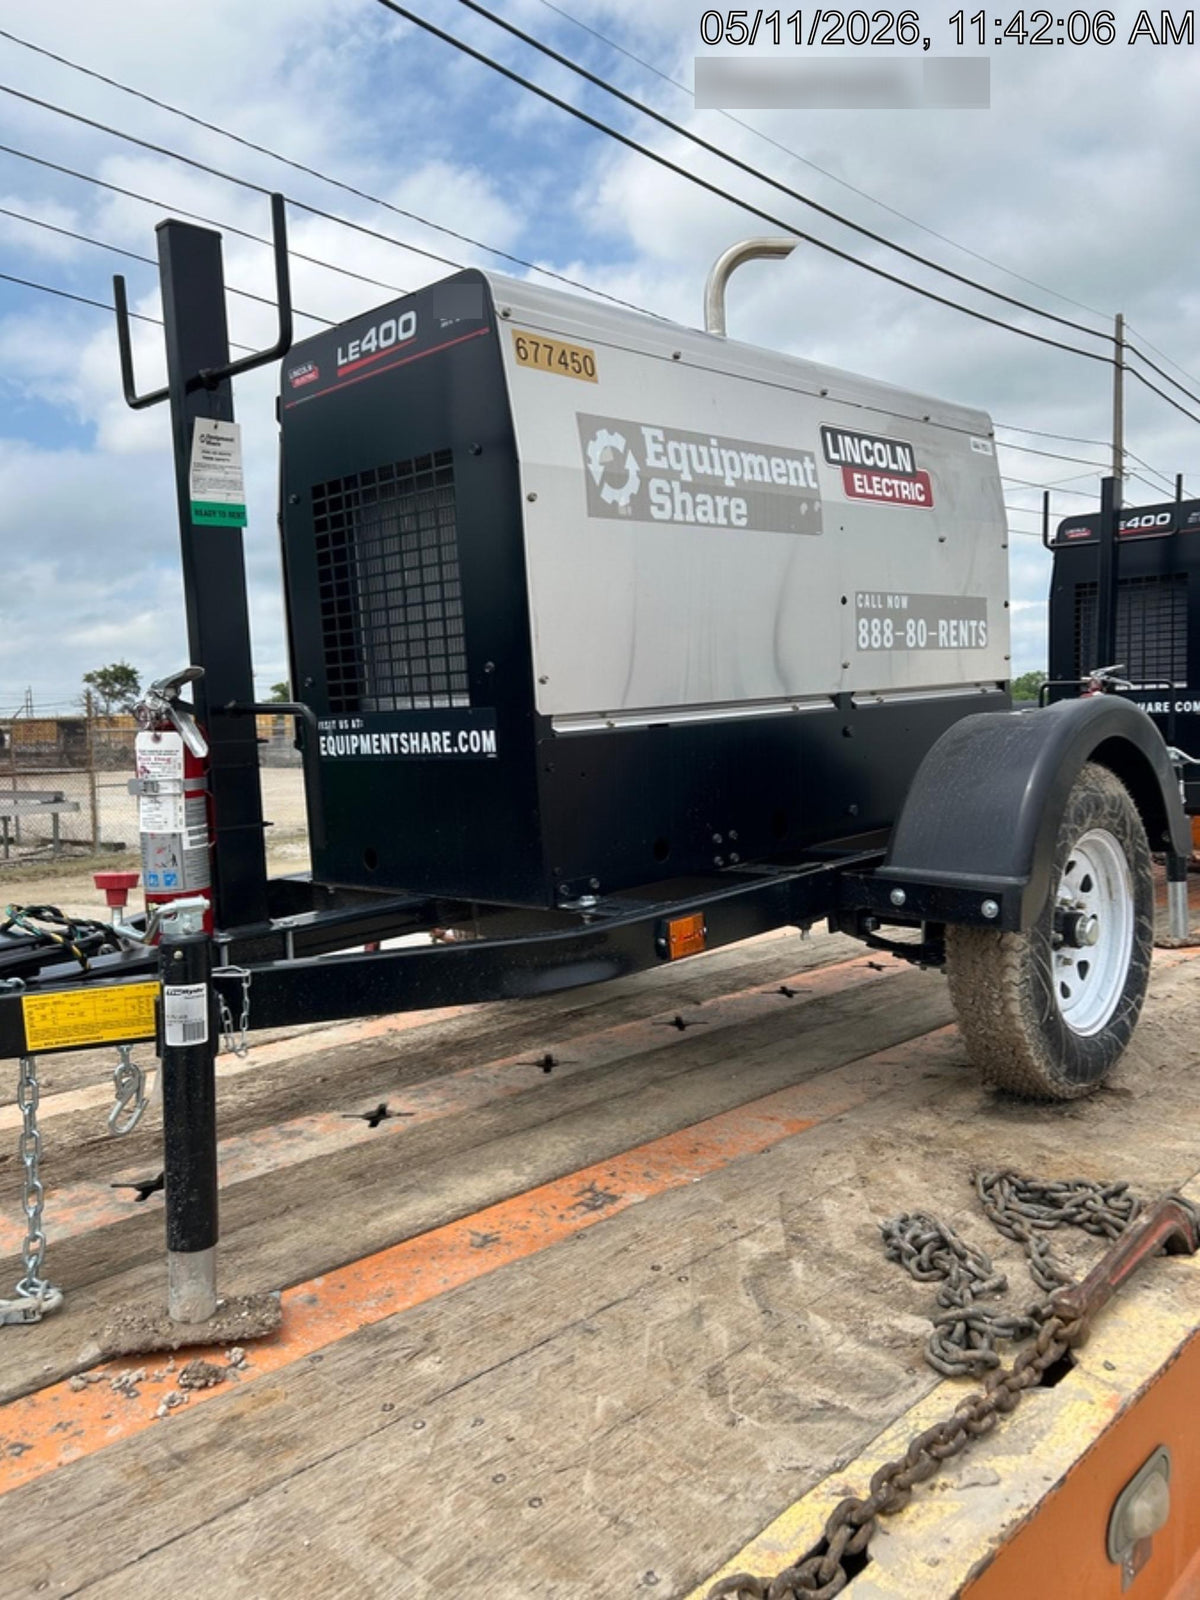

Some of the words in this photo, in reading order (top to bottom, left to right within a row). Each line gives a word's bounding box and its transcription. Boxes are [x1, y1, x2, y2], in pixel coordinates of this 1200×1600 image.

[337, 311, 417, 366] LE400
[515, 336, 595, 378] 677450
[641, 426, 818, 489] Equipment
[825, 431, 912, 473] LINCOLN
[649, 478, 749, 527] Share
[853, 472, 926, 502] ELECTRIC
[856, 593, 883, 609] CALL
[886, 595, 909, 609] NOW
[857, 617, 988, 649] 888-80-RENTS
[319, 729, 497, 756] EQUIPMENTSHARE.COM
